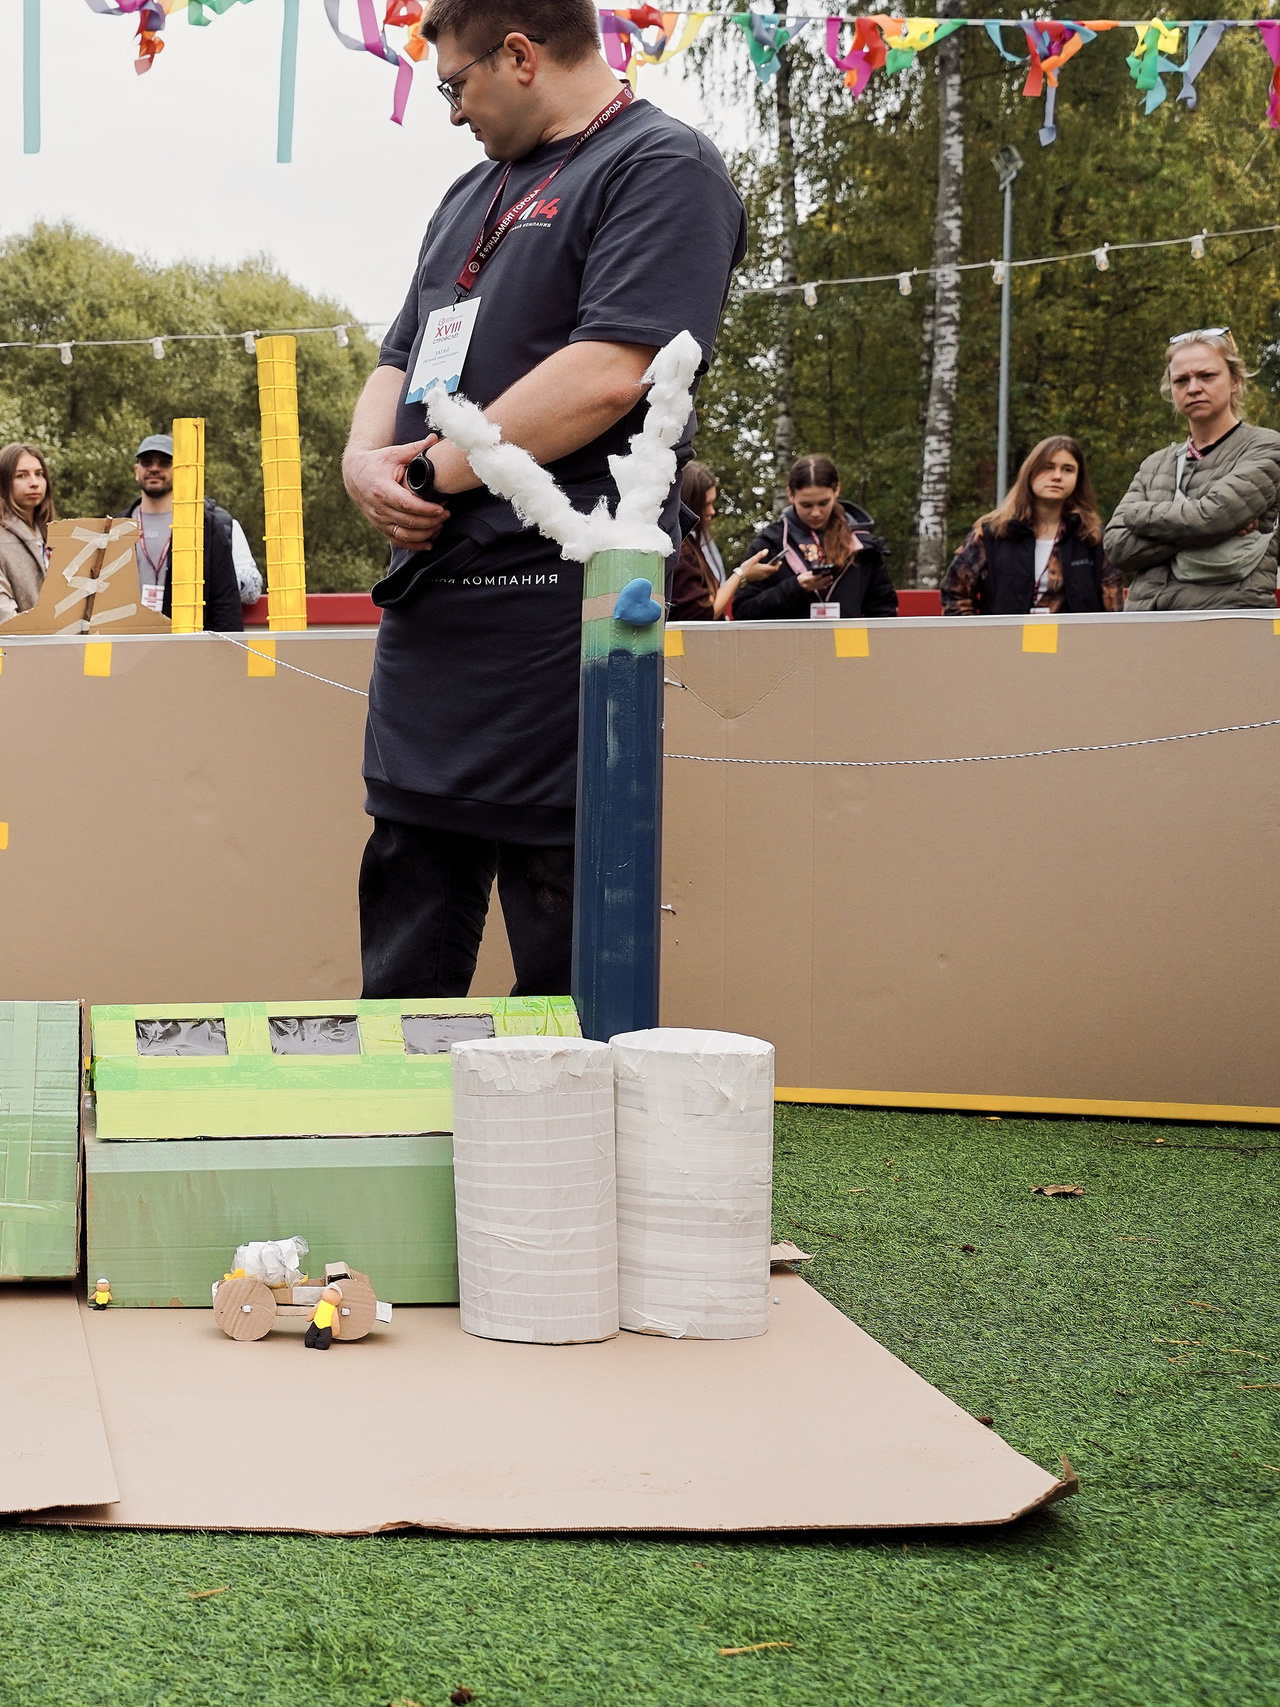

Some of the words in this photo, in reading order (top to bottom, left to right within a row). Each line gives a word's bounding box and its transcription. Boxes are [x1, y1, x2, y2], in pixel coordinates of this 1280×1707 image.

[598, 100, 623, 124] ГОРОДА
[479, 251, 487, 259] Я
[483, 212, 516, 253] ФУНДАМЕНТ
[512, 188, 541, 214] ГОРОДА
[434, 321, 462, 338] XVIII
[462, 573, 559, 586] КОМПАНИЯ
